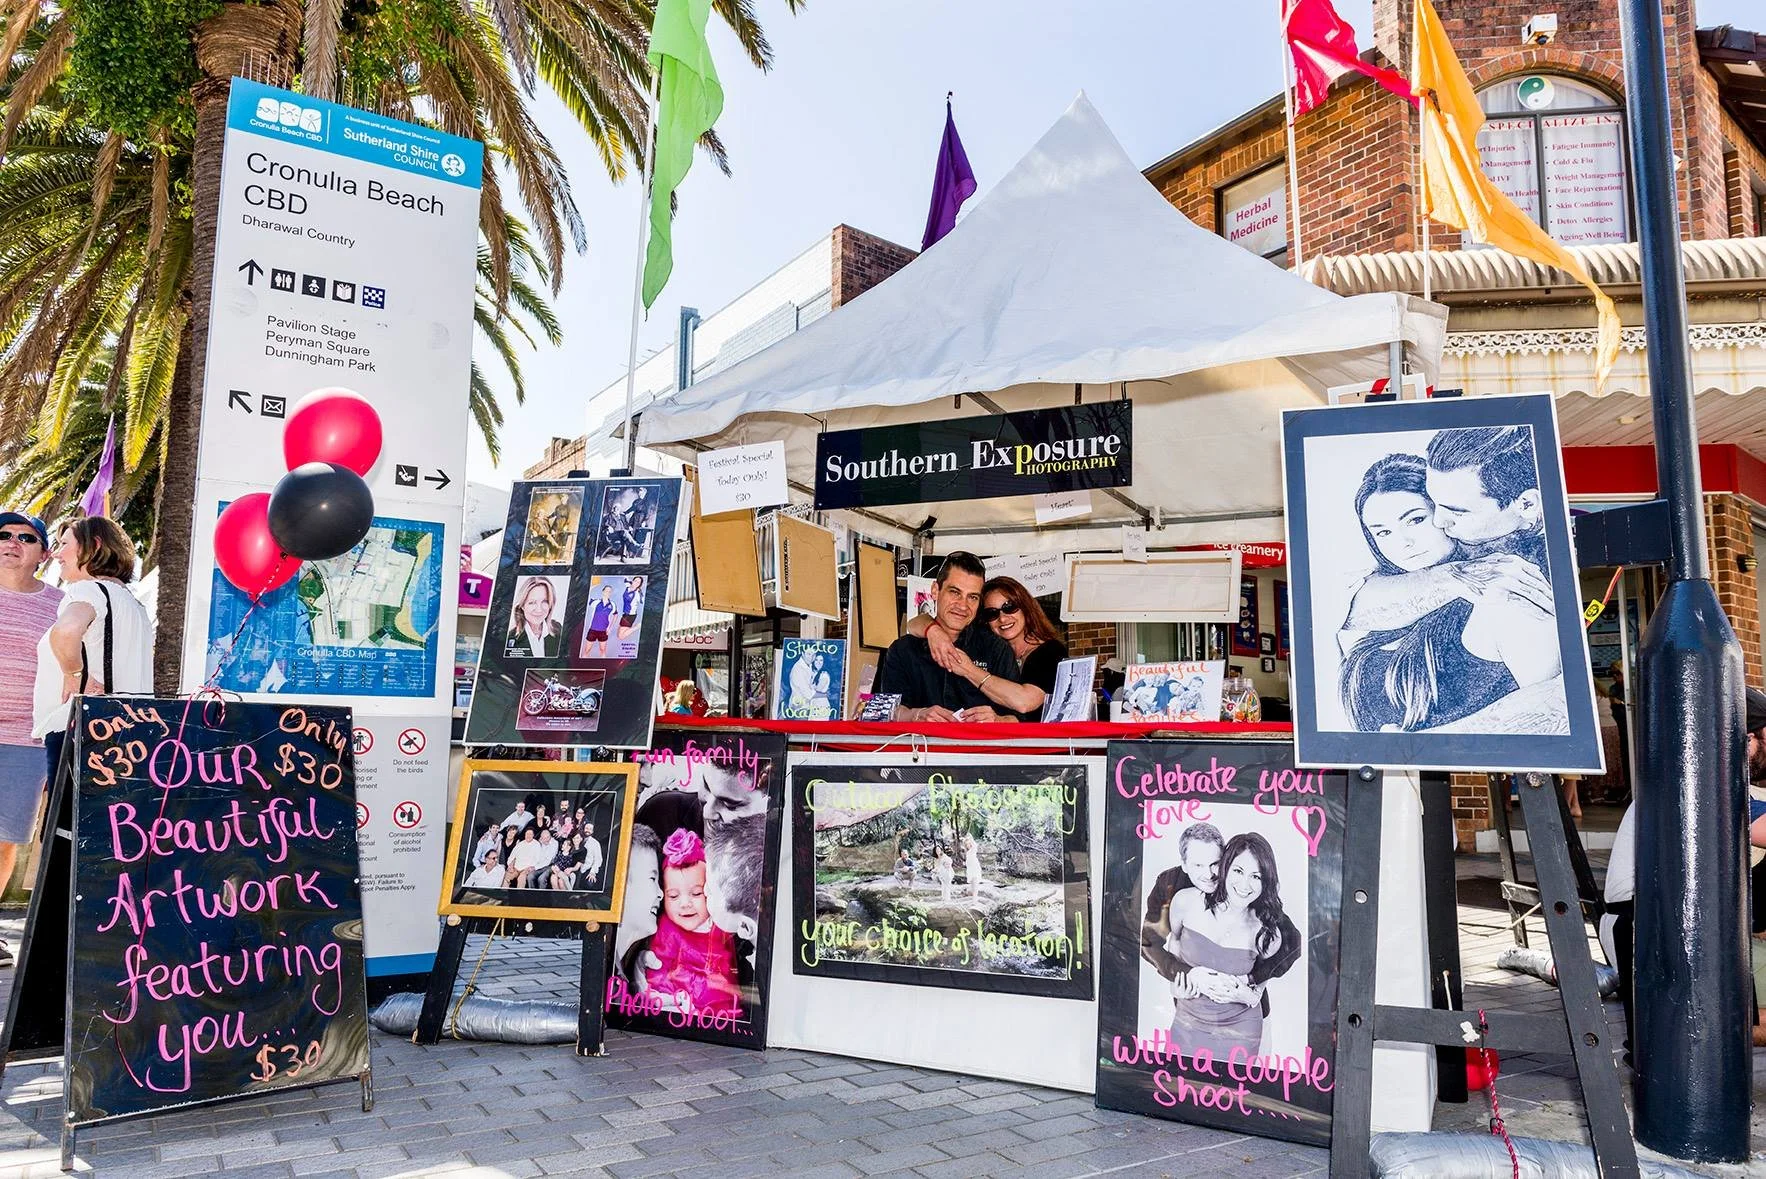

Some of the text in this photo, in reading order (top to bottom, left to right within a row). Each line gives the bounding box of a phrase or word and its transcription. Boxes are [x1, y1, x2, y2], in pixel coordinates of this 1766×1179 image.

[250, 119, 322, 142] Cronulla Beach CBD
[344, 128, 439, 161] Sutherland Shire
[1552, 143, 1579, 151] Fatigue
[394, 153, 438, 172] COUNCIL
[1488, 145, 1515, 153] Injuries
[246, 152, 444, 216] Cronulla Beach
[1580, 172, 1624, 180] Management
[243, 184, 308, 215] CBD
[1236, 198, 1271, 222] Herbal
[242, 214, 355, 248] Dharawal Country
[1230, 214, 1278, 242] Medicine
[266, 330, 370, 357] Peryman Square
[267, 315, 356, 340] Pavilion Stage
[265, 345, 376, 372] Dunningham Park
[709, 450, 774, 469] Festival Special
[826, 434, 1121, 483] Southern Exposure
[717, 476, 739, 486] Today
[298, 648, 377, 660] Cronulla CBD Map
[786, 640, 838, 659] Studio
[1130, 662, 1210, 681] Beautiful
[88, 704, 170, 741] Only
[279, 708, 347, 764] Only
[87, 740, 147, 786] $30
[274, 742, 342, 790] $30
[680, 739, 759, 791] family
[1115, 755, 1332, 814] Celebrate your
[805, 773, 1077, 834] Outdoor Photography
[1135, 799, 1212, 840] Love
[108, 797, 334, 863] Beautiful
[97, 869, 338, 935] Artwork
[801, 919, 859, 967] your
[865, 919, 944, 955] choice
[951, 928, 971, 965] of
[102, 932, 342, 1024] featuring
[605, 976, 662, 1015] Photo
[250, 1040, 322, 1082] $30
[1113, 1028, 1187, 1071] with
[1192, 1047, 1219, 1077] a
